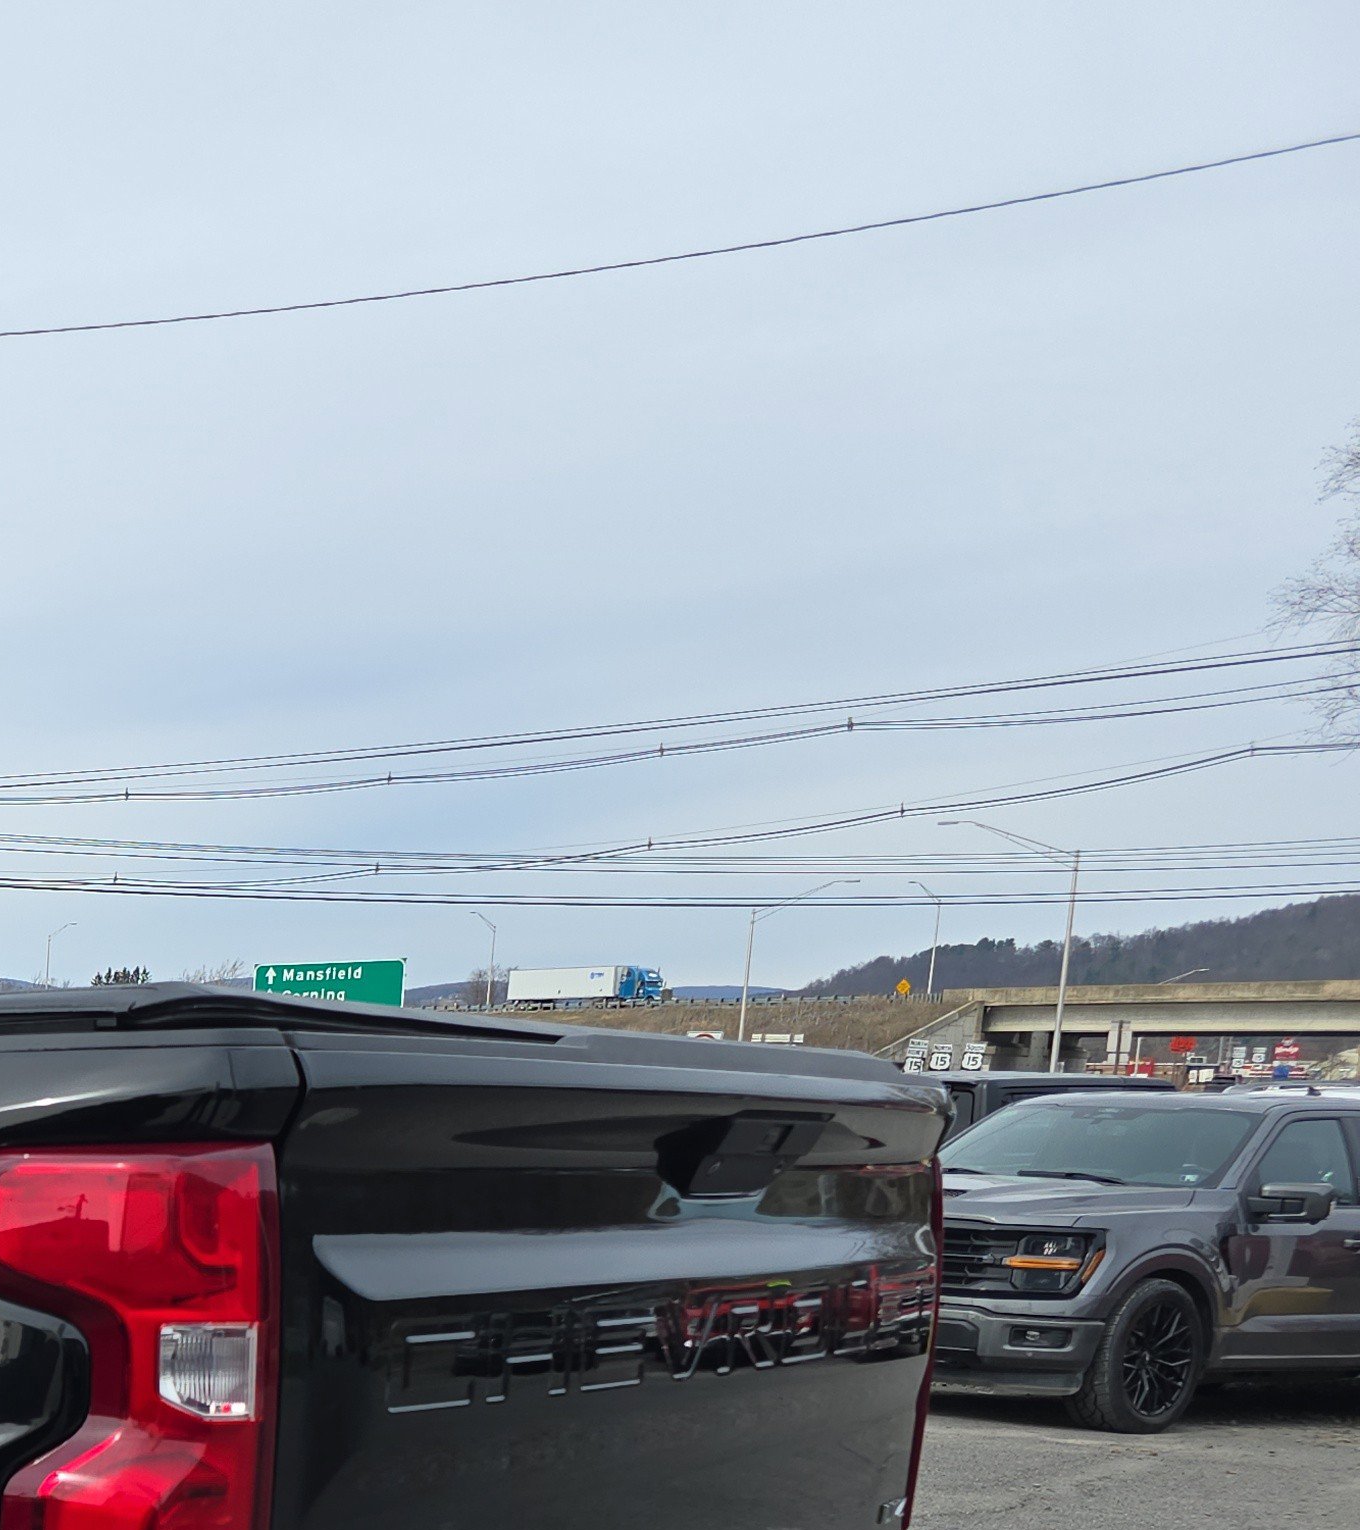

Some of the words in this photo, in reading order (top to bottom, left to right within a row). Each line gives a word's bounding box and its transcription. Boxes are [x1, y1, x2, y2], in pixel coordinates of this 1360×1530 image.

[282, 966, 362, 982] Mansfield
[909, 1060, 921, 1071] 15
[935, 1056, 948, 1066] 15
[967, 1056, 979, 1066] 15
